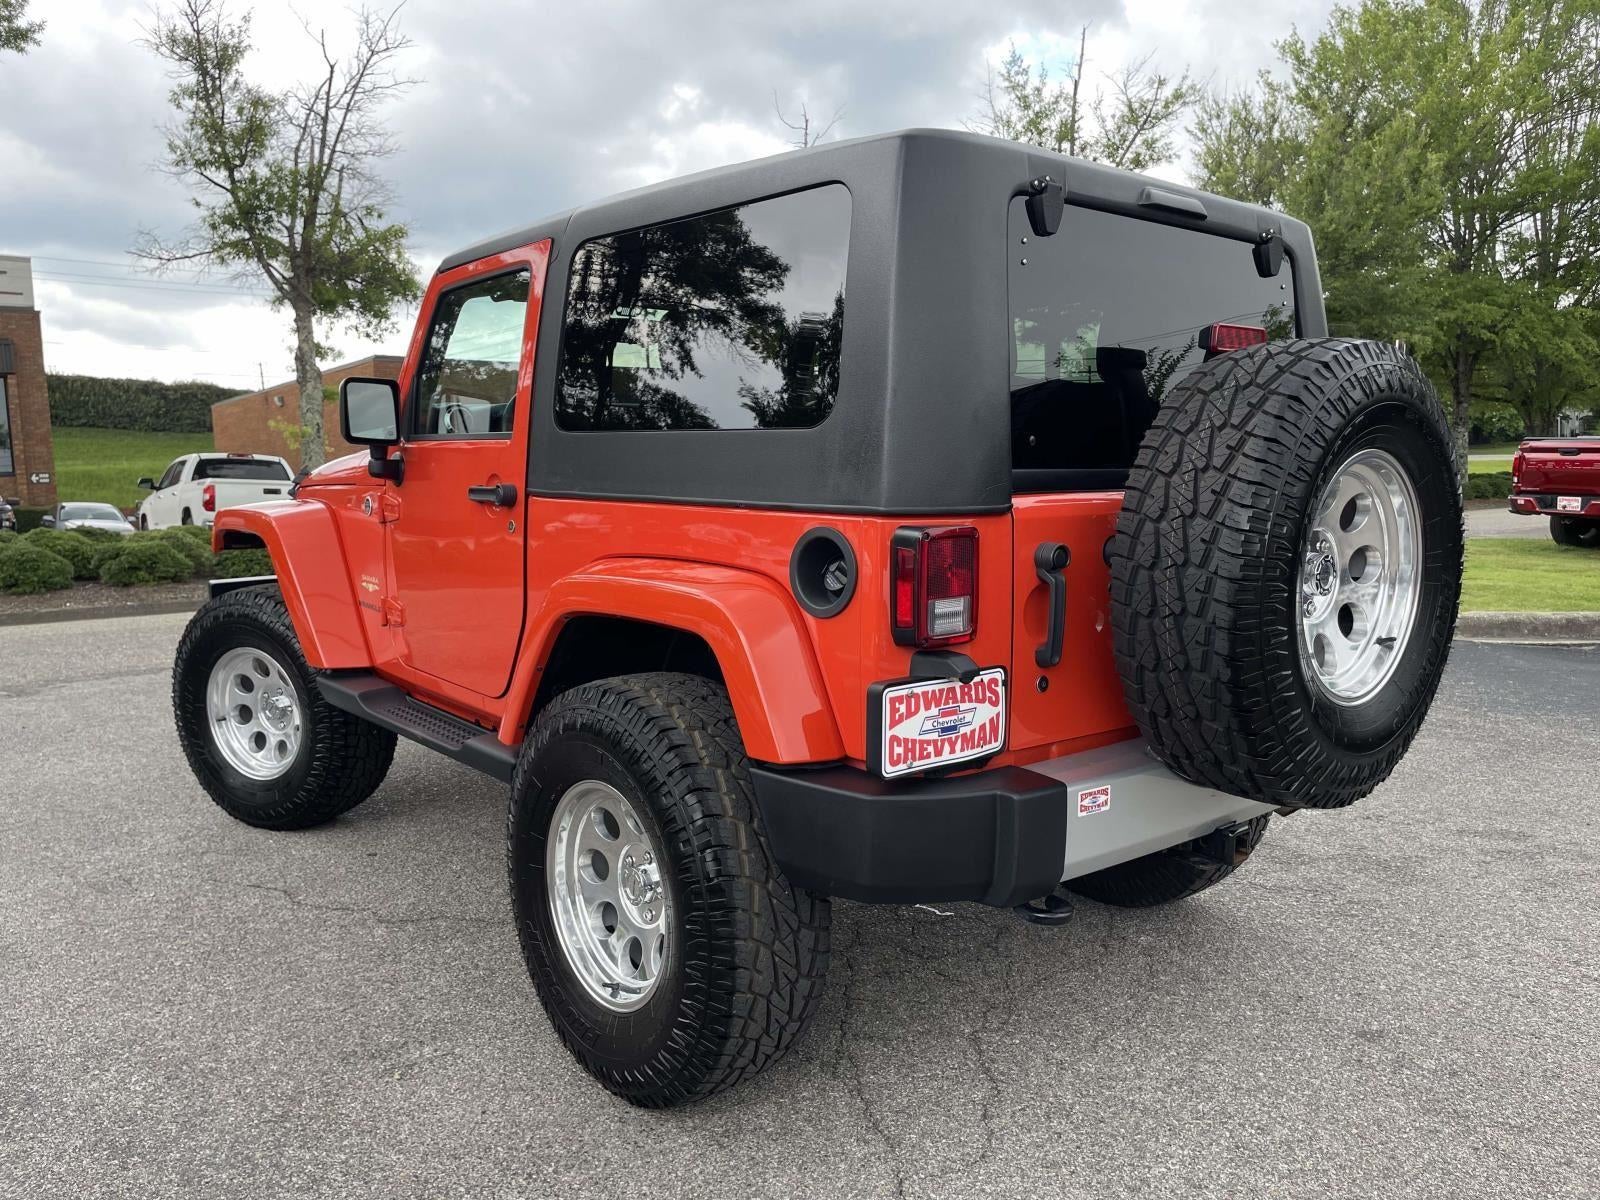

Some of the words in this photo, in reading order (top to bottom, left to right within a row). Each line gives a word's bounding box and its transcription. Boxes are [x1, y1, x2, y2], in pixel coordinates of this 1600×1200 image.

[888, 677, 1000, 731] EDWARDS
[931, 715, 966, 728] Chevrolet
[888, 711, 1001, 768] CHEVYMAN
[1080, 787, 1109, 803] EDWARDS
